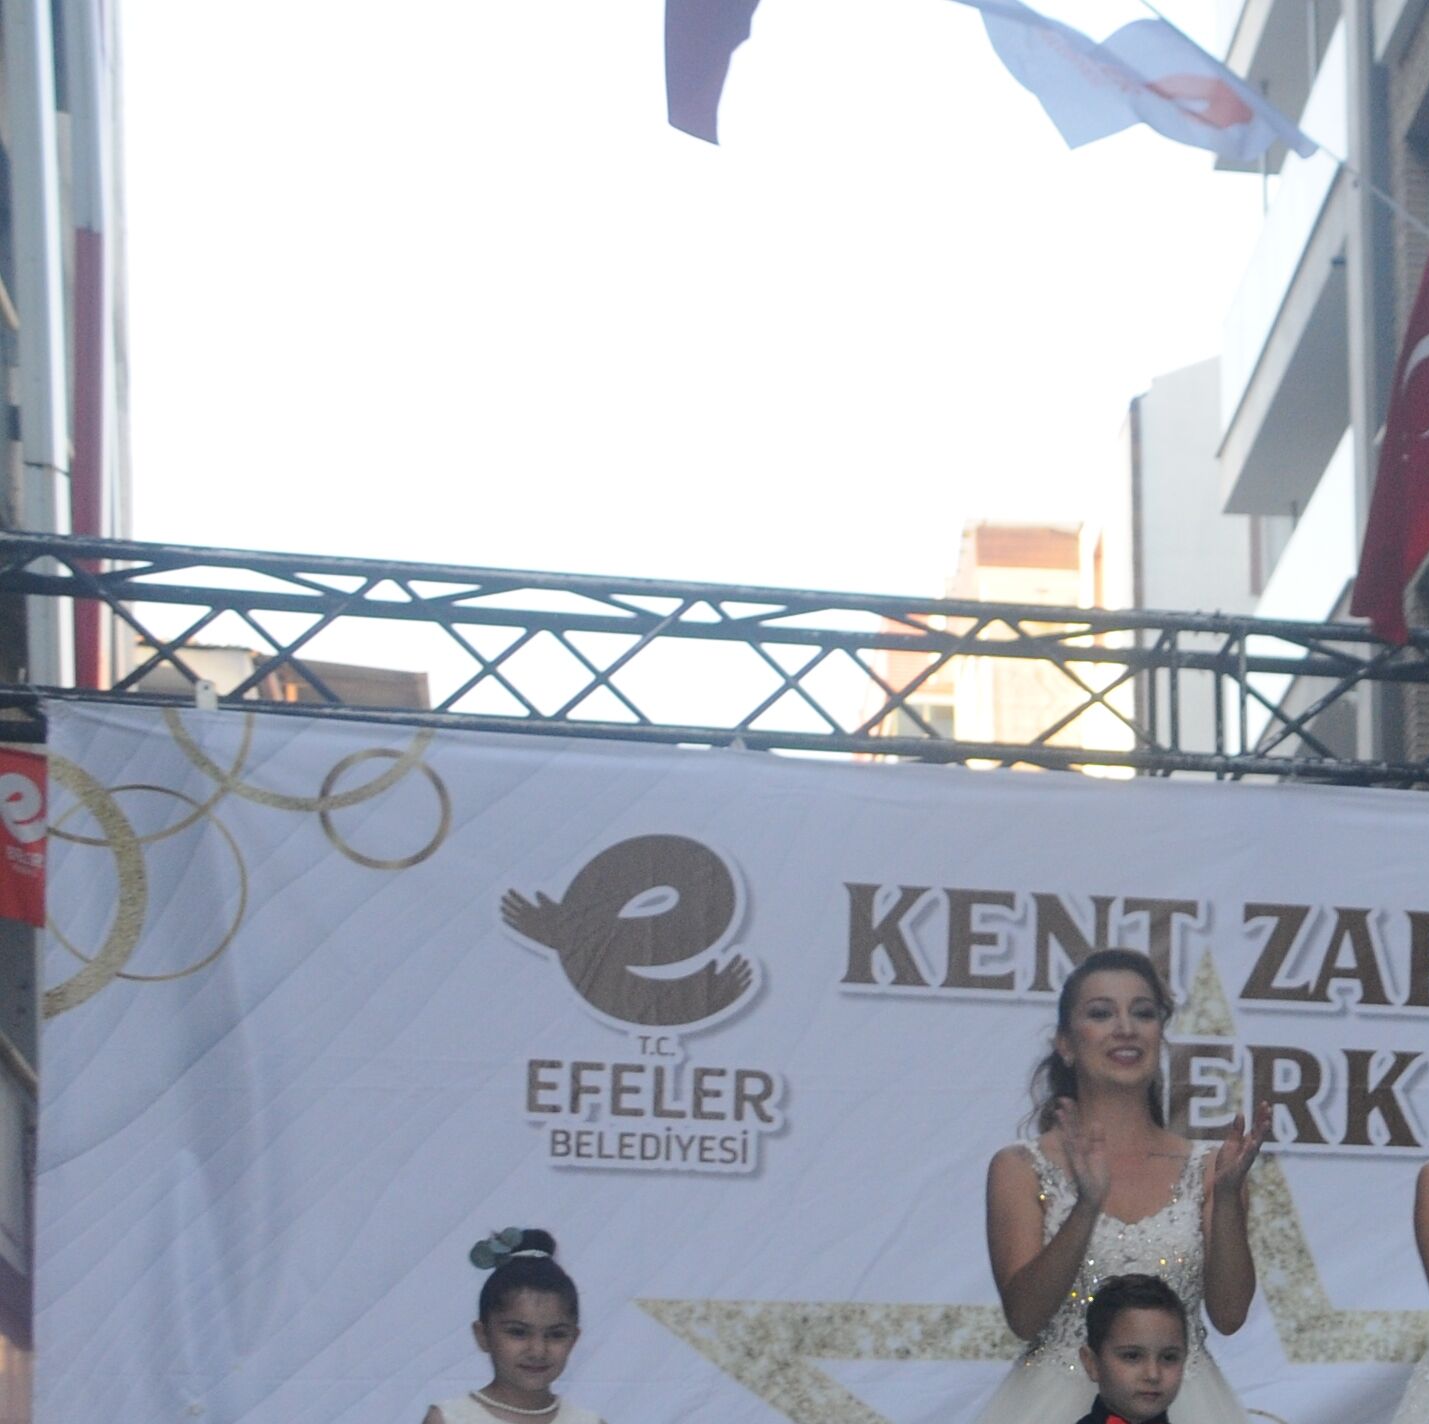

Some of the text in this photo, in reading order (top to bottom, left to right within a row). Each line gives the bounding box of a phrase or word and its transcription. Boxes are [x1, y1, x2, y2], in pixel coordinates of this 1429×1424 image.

[840, 881, 1198, 993] KENT
[638, 1036, 676, 1057] T.C.
[525, 1060, 775, 1124] EFELER
[550, 1127, 750, 1165] BELEDİYESİ
